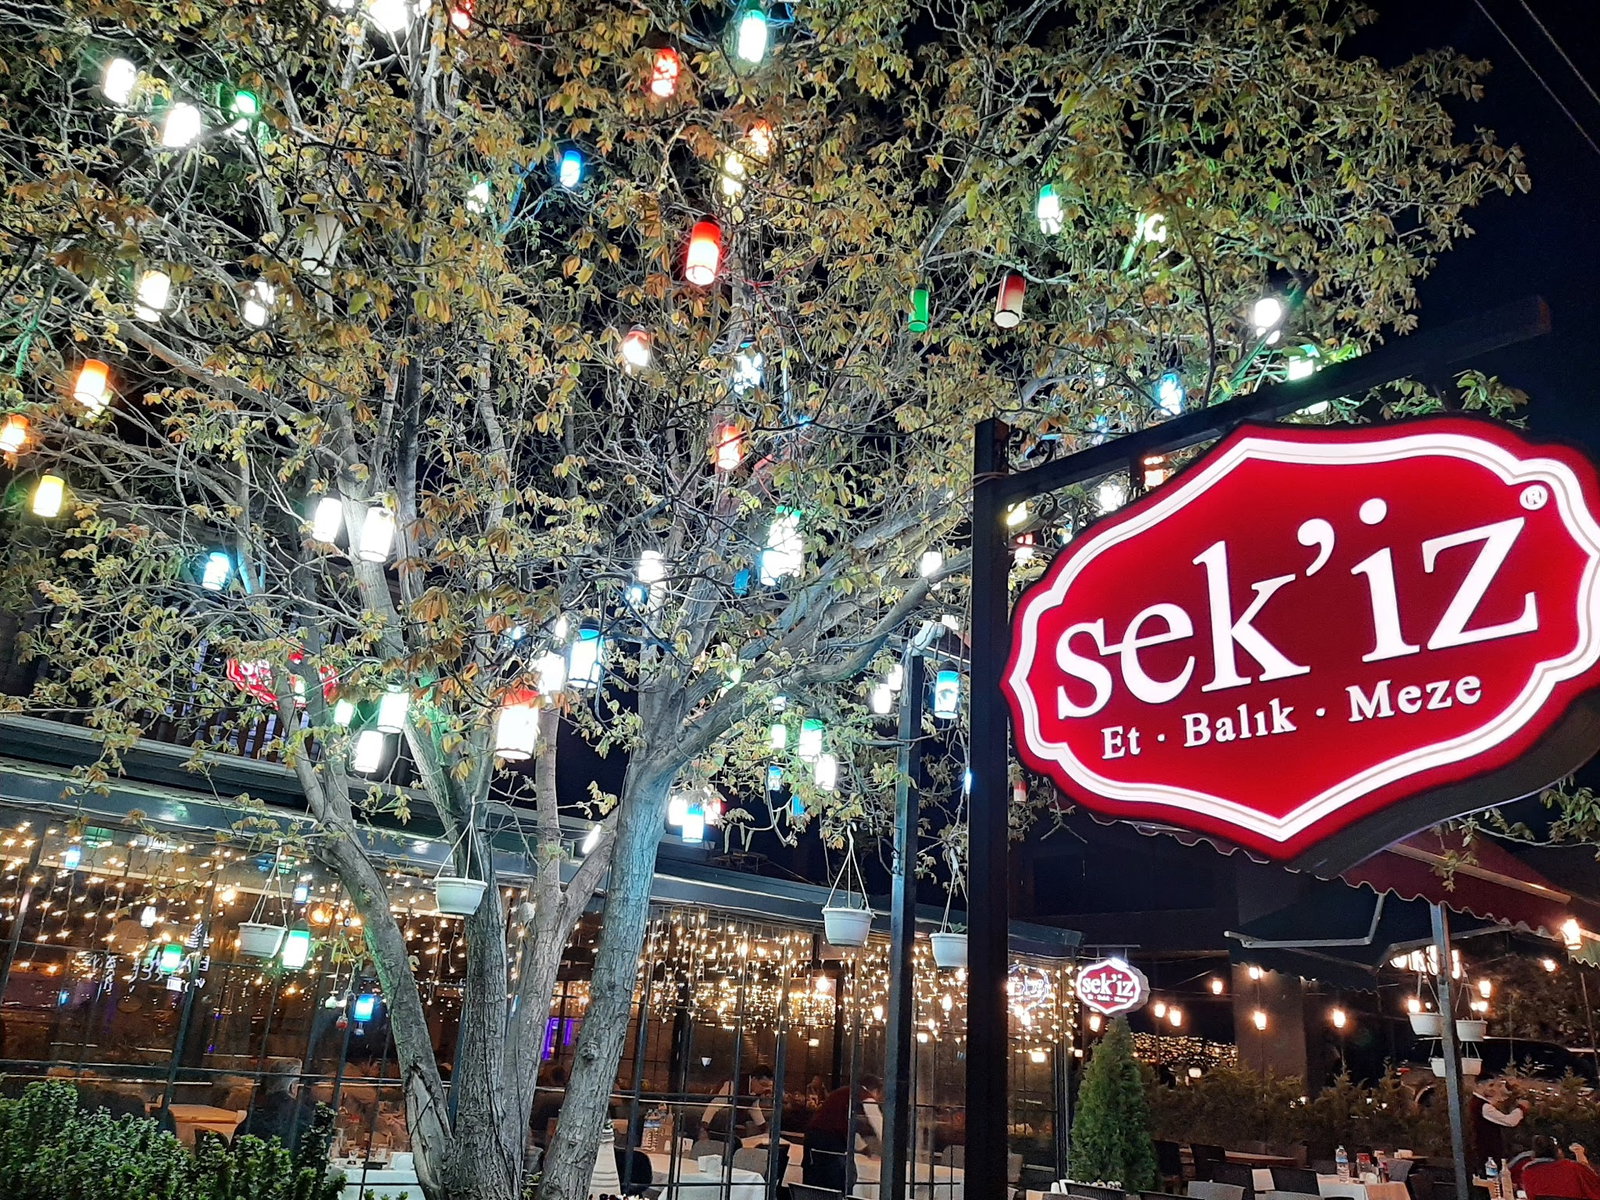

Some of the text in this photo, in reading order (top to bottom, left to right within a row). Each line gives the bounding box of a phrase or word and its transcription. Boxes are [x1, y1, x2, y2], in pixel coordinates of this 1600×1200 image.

[1056, 498, 1539, 720] sek'iz
[1100, 675, 1482, 760] Et Balık Meze
[1081, 972, 1135, 998] sek'iz
